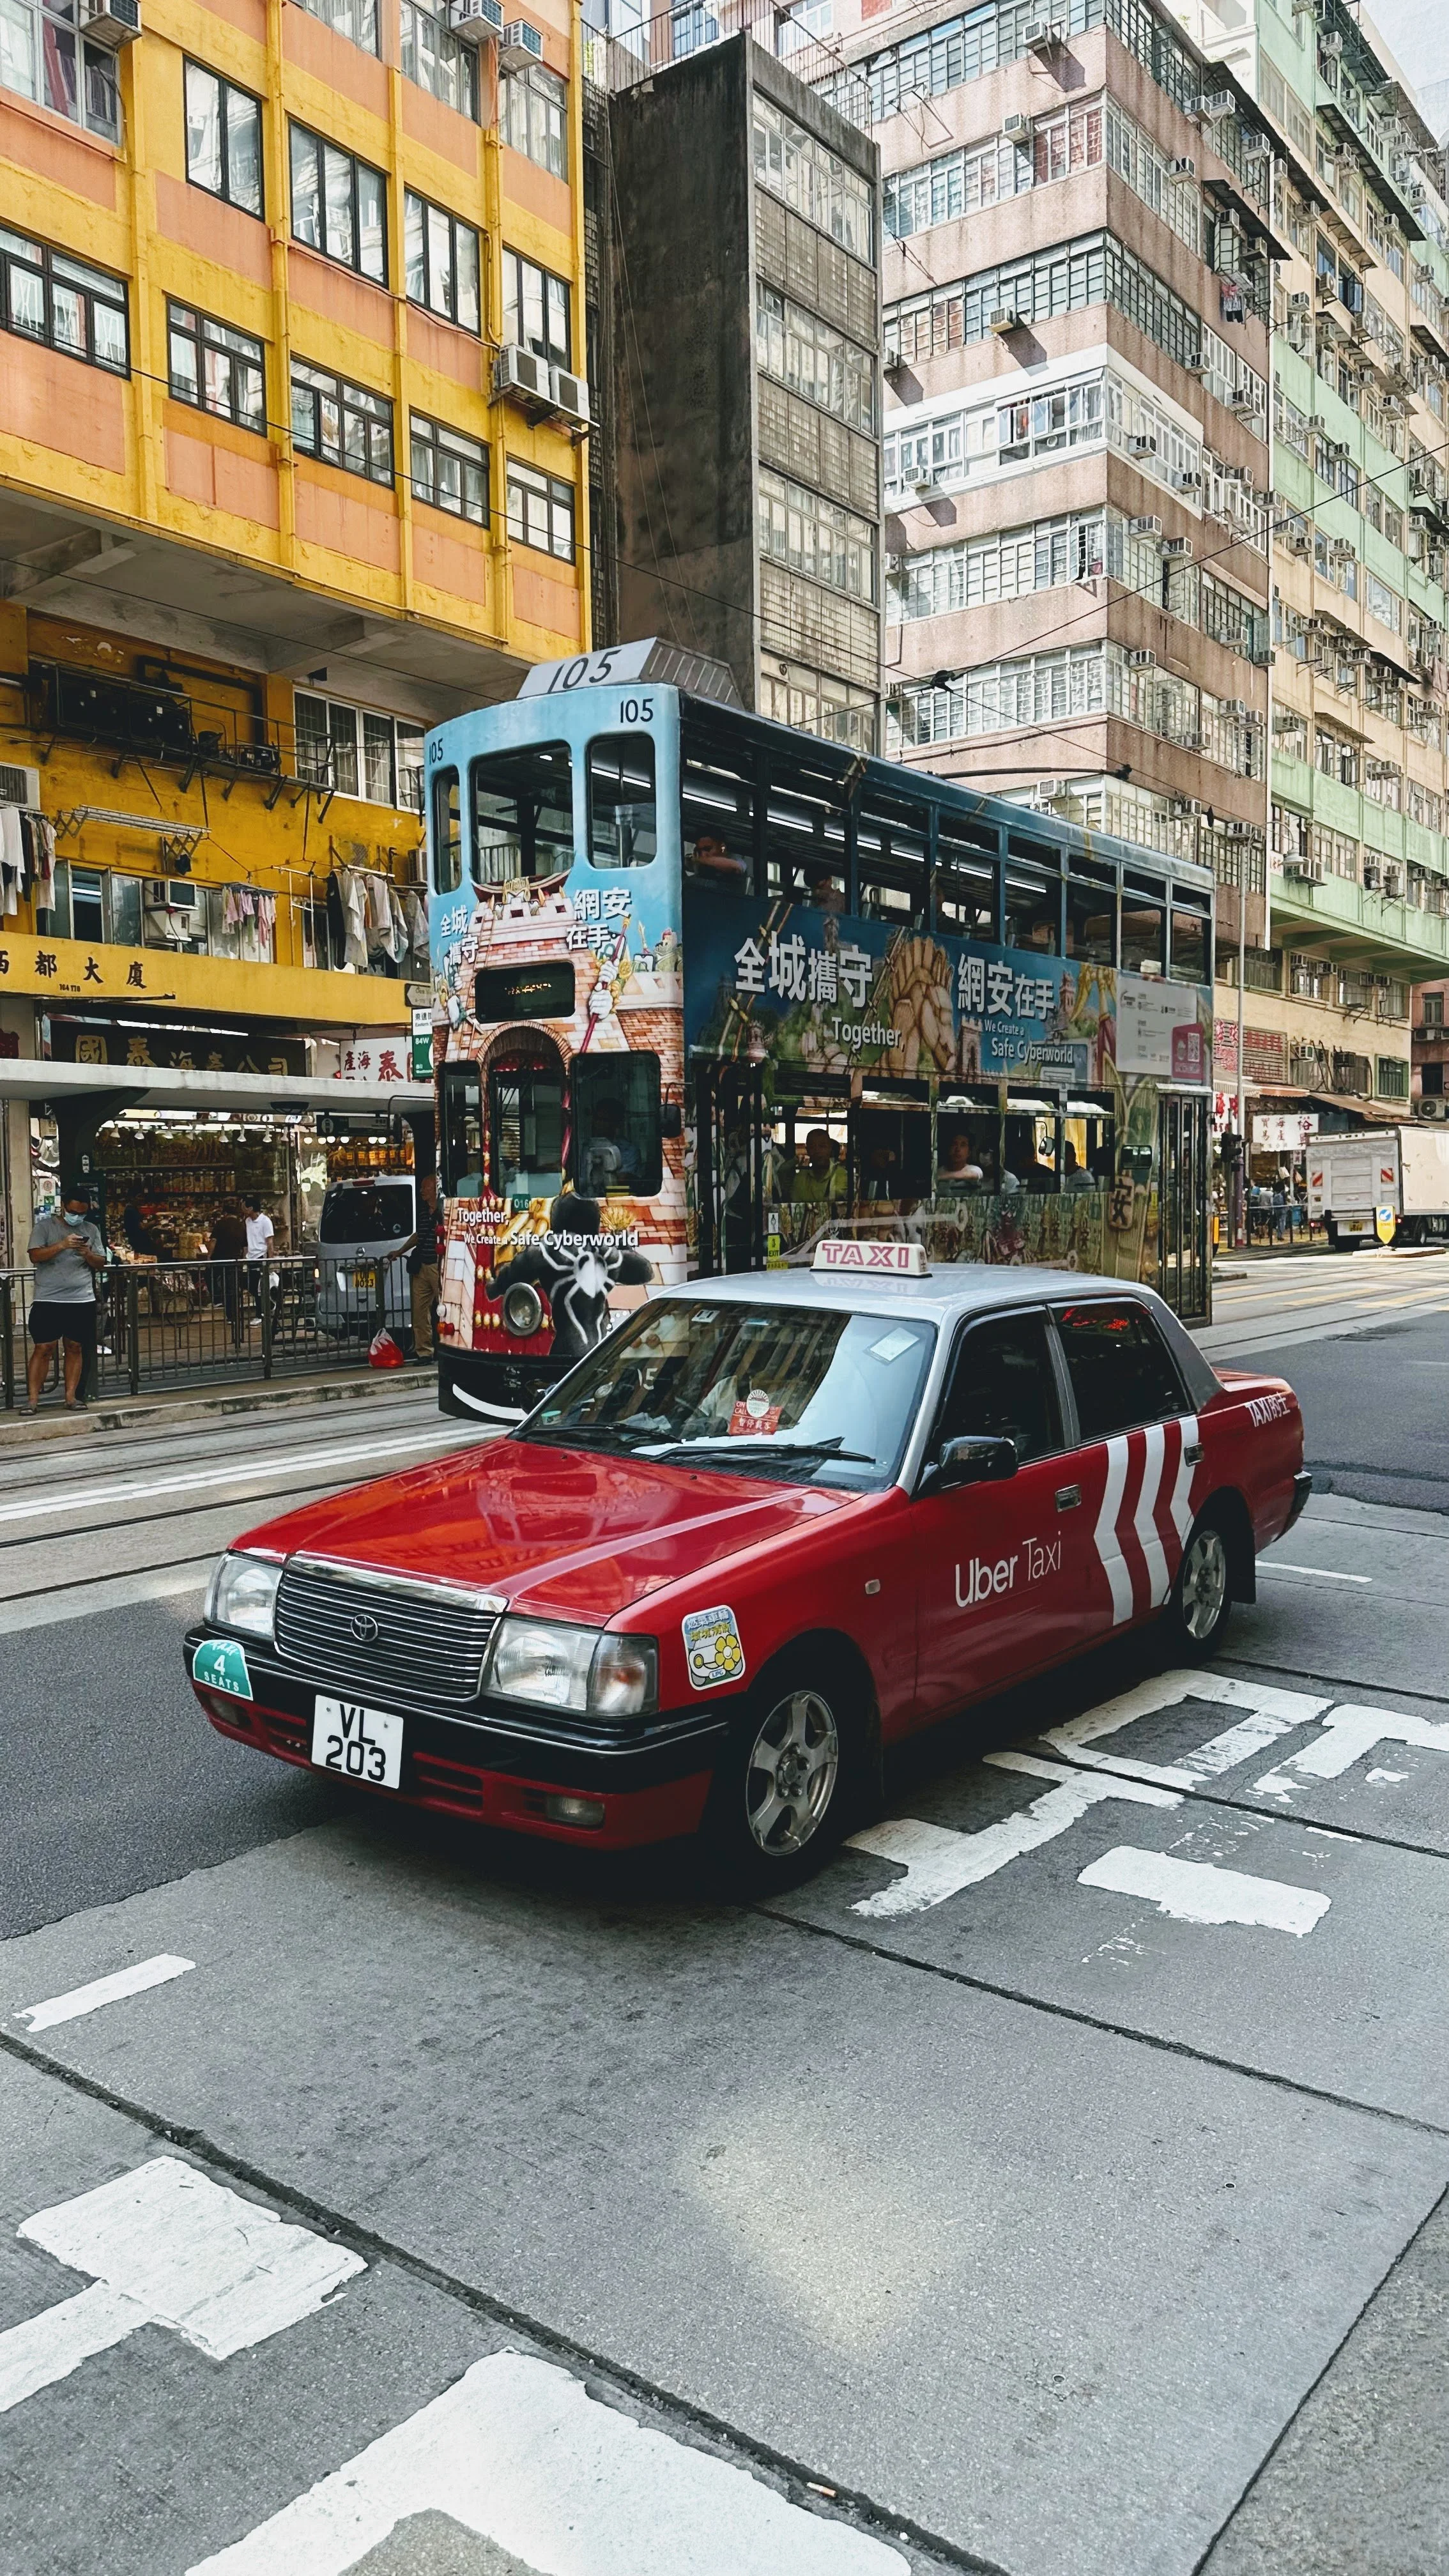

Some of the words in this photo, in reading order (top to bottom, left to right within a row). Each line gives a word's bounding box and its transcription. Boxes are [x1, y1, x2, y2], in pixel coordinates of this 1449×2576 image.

[547, 649, 621, 693] 105
[620, 698, 654, 723] 105
[429, 738, 443, 765] 105
[575, 887, 631, 920] 網安
[440, 905, 468, 937] 全城
[566, 924, 609, 951] 在手
[734, 931, 873, 1008] 全城攜守
[958, 953, 1054, 1020] 網安在手
[985, 1019, 995, 1032] We
[997, 1022, 1019, 1035] Create
[1020, 1027, 1025, 1035] a
[992, 1038, 1015, 1058] Safe
[1017, 1040, 1074, 1064] Cyberworld
[457, 1207, 509, 1227] Together,
[514, 1198, 529, 1209] 016
[464, 1232, 476, 1244] We
[476, 1233, 500, 1245] Create
[510, 1231, 540, 1246] Safe
[543, 1229, 639, 1250] Cyberworld
[822, 1243, 909, 1268] TAXI
[734, 1407, 747, 1416] CALL
[1245, 1397, 1273, 1427] TAXI
[955, 1555, 1018, 1607] Uber
[1022, 1530, 1061, 1581] Taxi
[213, 1655, 226, 1676] 4
[204, 1671, 240, 1692] SEATS
[339, 1703, 376, 1746] VL
[325, 1735, 386, 1782] 203
